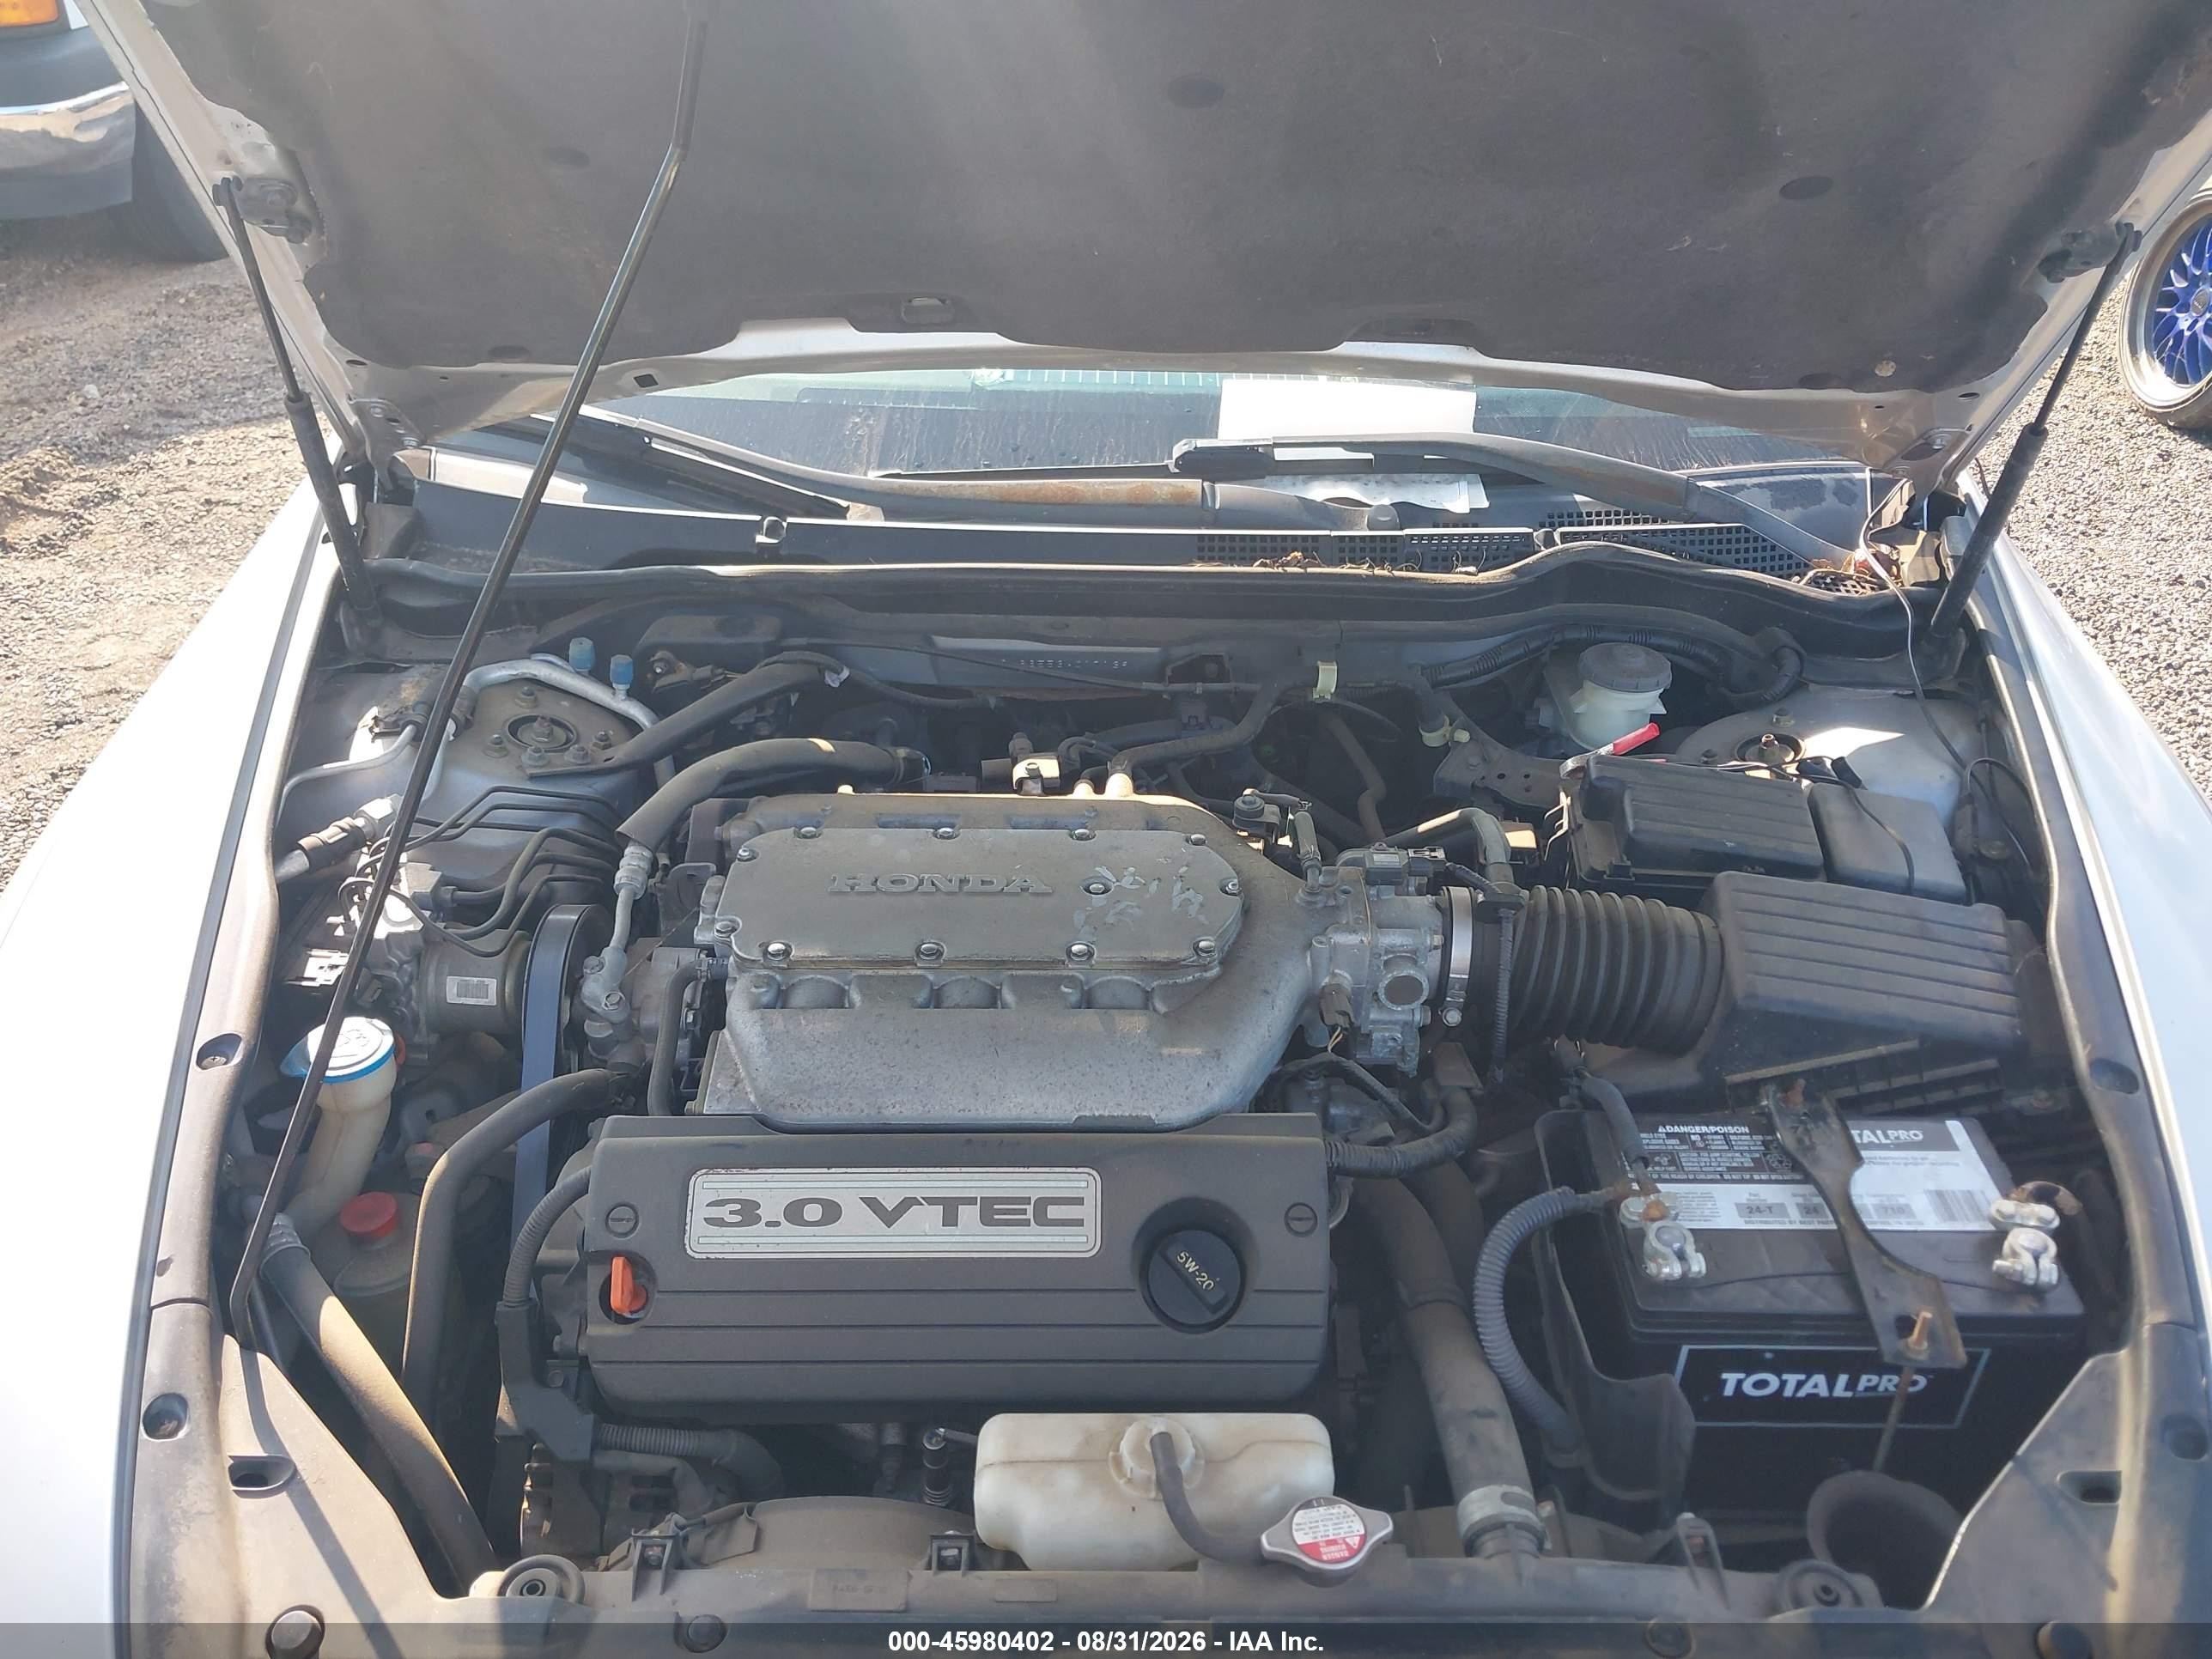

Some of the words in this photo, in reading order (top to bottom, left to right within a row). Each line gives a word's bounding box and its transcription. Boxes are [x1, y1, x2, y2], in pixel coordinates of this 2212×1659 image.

[828, 873, 1052, 894] HONDA
[1666, 1125, 1750, 1134] DANGER/POISON
[1850, 1129, 1923, 1143] TALPRO
[703, 1196, 842, 1228] 3.0
[859, 1196, 1085, 1227] VTEC
[1747, 1206, 1773, 1214] 24-T
[1176, 1250, 1217, 1291] 5W-20
[1721, 1372, 1929, 1397] TOTALPRO
